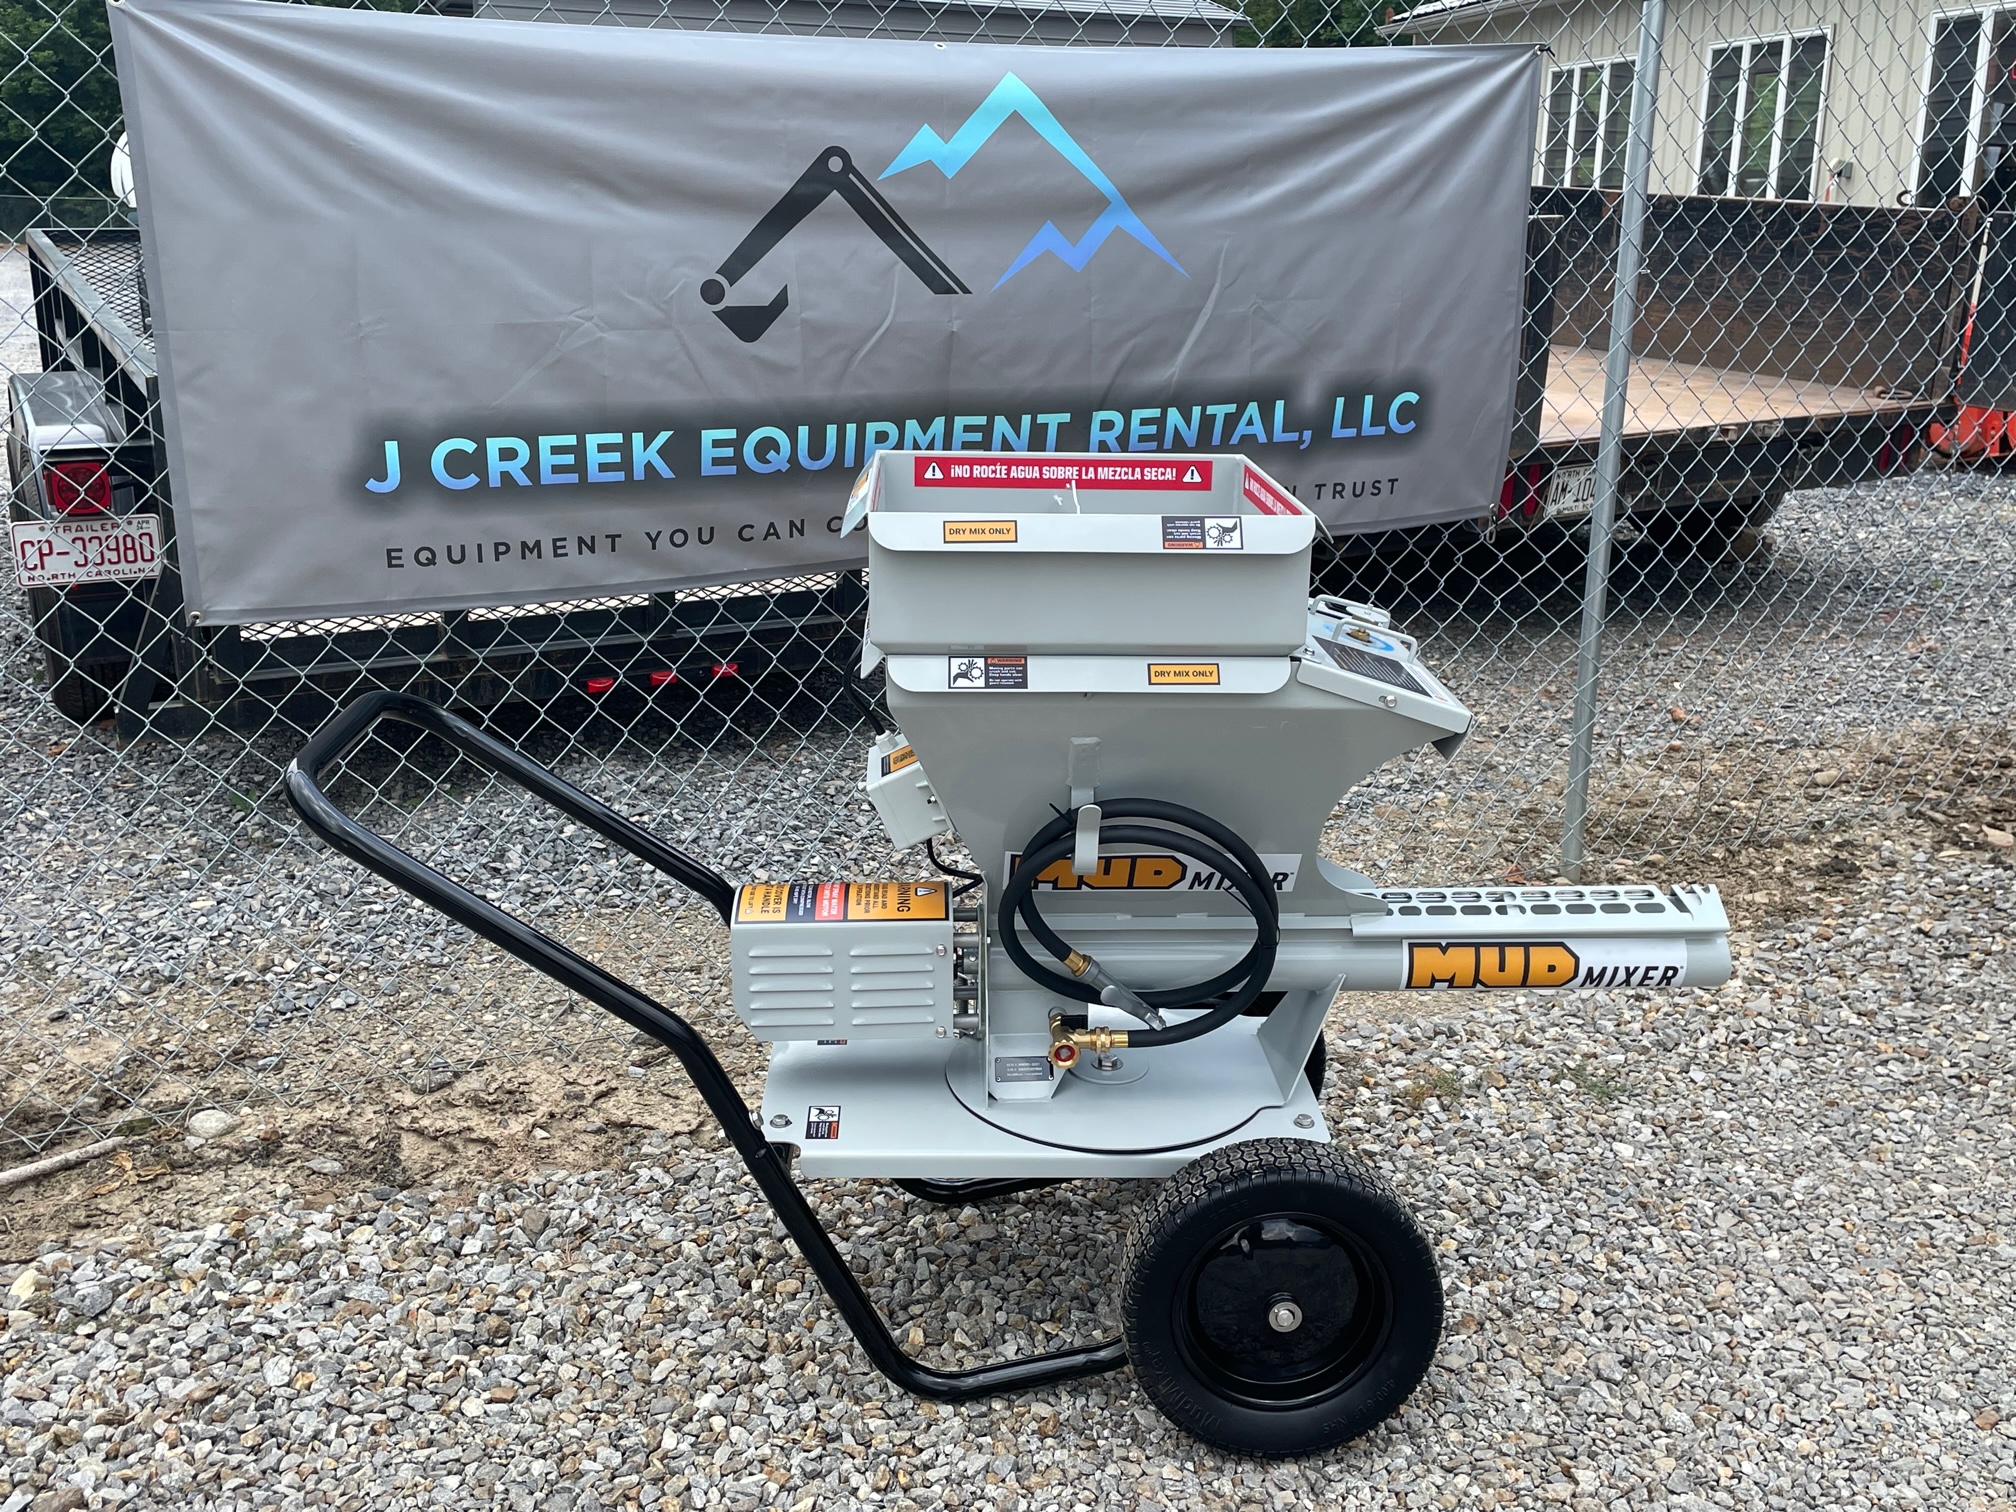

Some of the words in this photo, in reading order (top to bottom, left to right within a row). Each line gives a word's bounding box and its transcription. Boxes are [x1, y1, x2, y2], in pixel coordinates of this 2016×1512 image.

[365, 440, 401, 493] J
[430, 430, 676, 490] CREEK
[701, 412, 1070, 476] EQUIPMENT
[1090, 399, 1312, 452] RENTAL,
[1331, 391, 1420, 439] LLC
[972, 462, 1008, 479] ROCÍE
[1009, 466, 1040, 479] AGUA
[1042, 466, 1080, 480] SOBRE
[1081, 466, 1096, 480] LA
[1097, 467, 1142, 481] MEZCLA
[1143, 467, 1177, 481] SECA!
[1314, 478, 1399, 500] TRUST
[54, 522, 121, 534] TRAILER
[949, 527, 967, 535] DRY
[969, 527, 986, 535] MIX
[988, 527, 1012, 535] ONLY
[20, 532, 156, 571] CP-33980
[386, 533, 622, 569] EQUIPMENT
[644, 526, 716, 550] YOU
[738, 518, 806, 543] CAN
[1154, 670, 1171, 678] DRY
[1173, 670, 1190, 678] MIX
[1192, 669, 1214, 678] ONLY
[1188, 871, 1290, 890] MIR
[1405, 941, 1580, 989] MUD
[1579, 965, 1680, 988] MIXER
